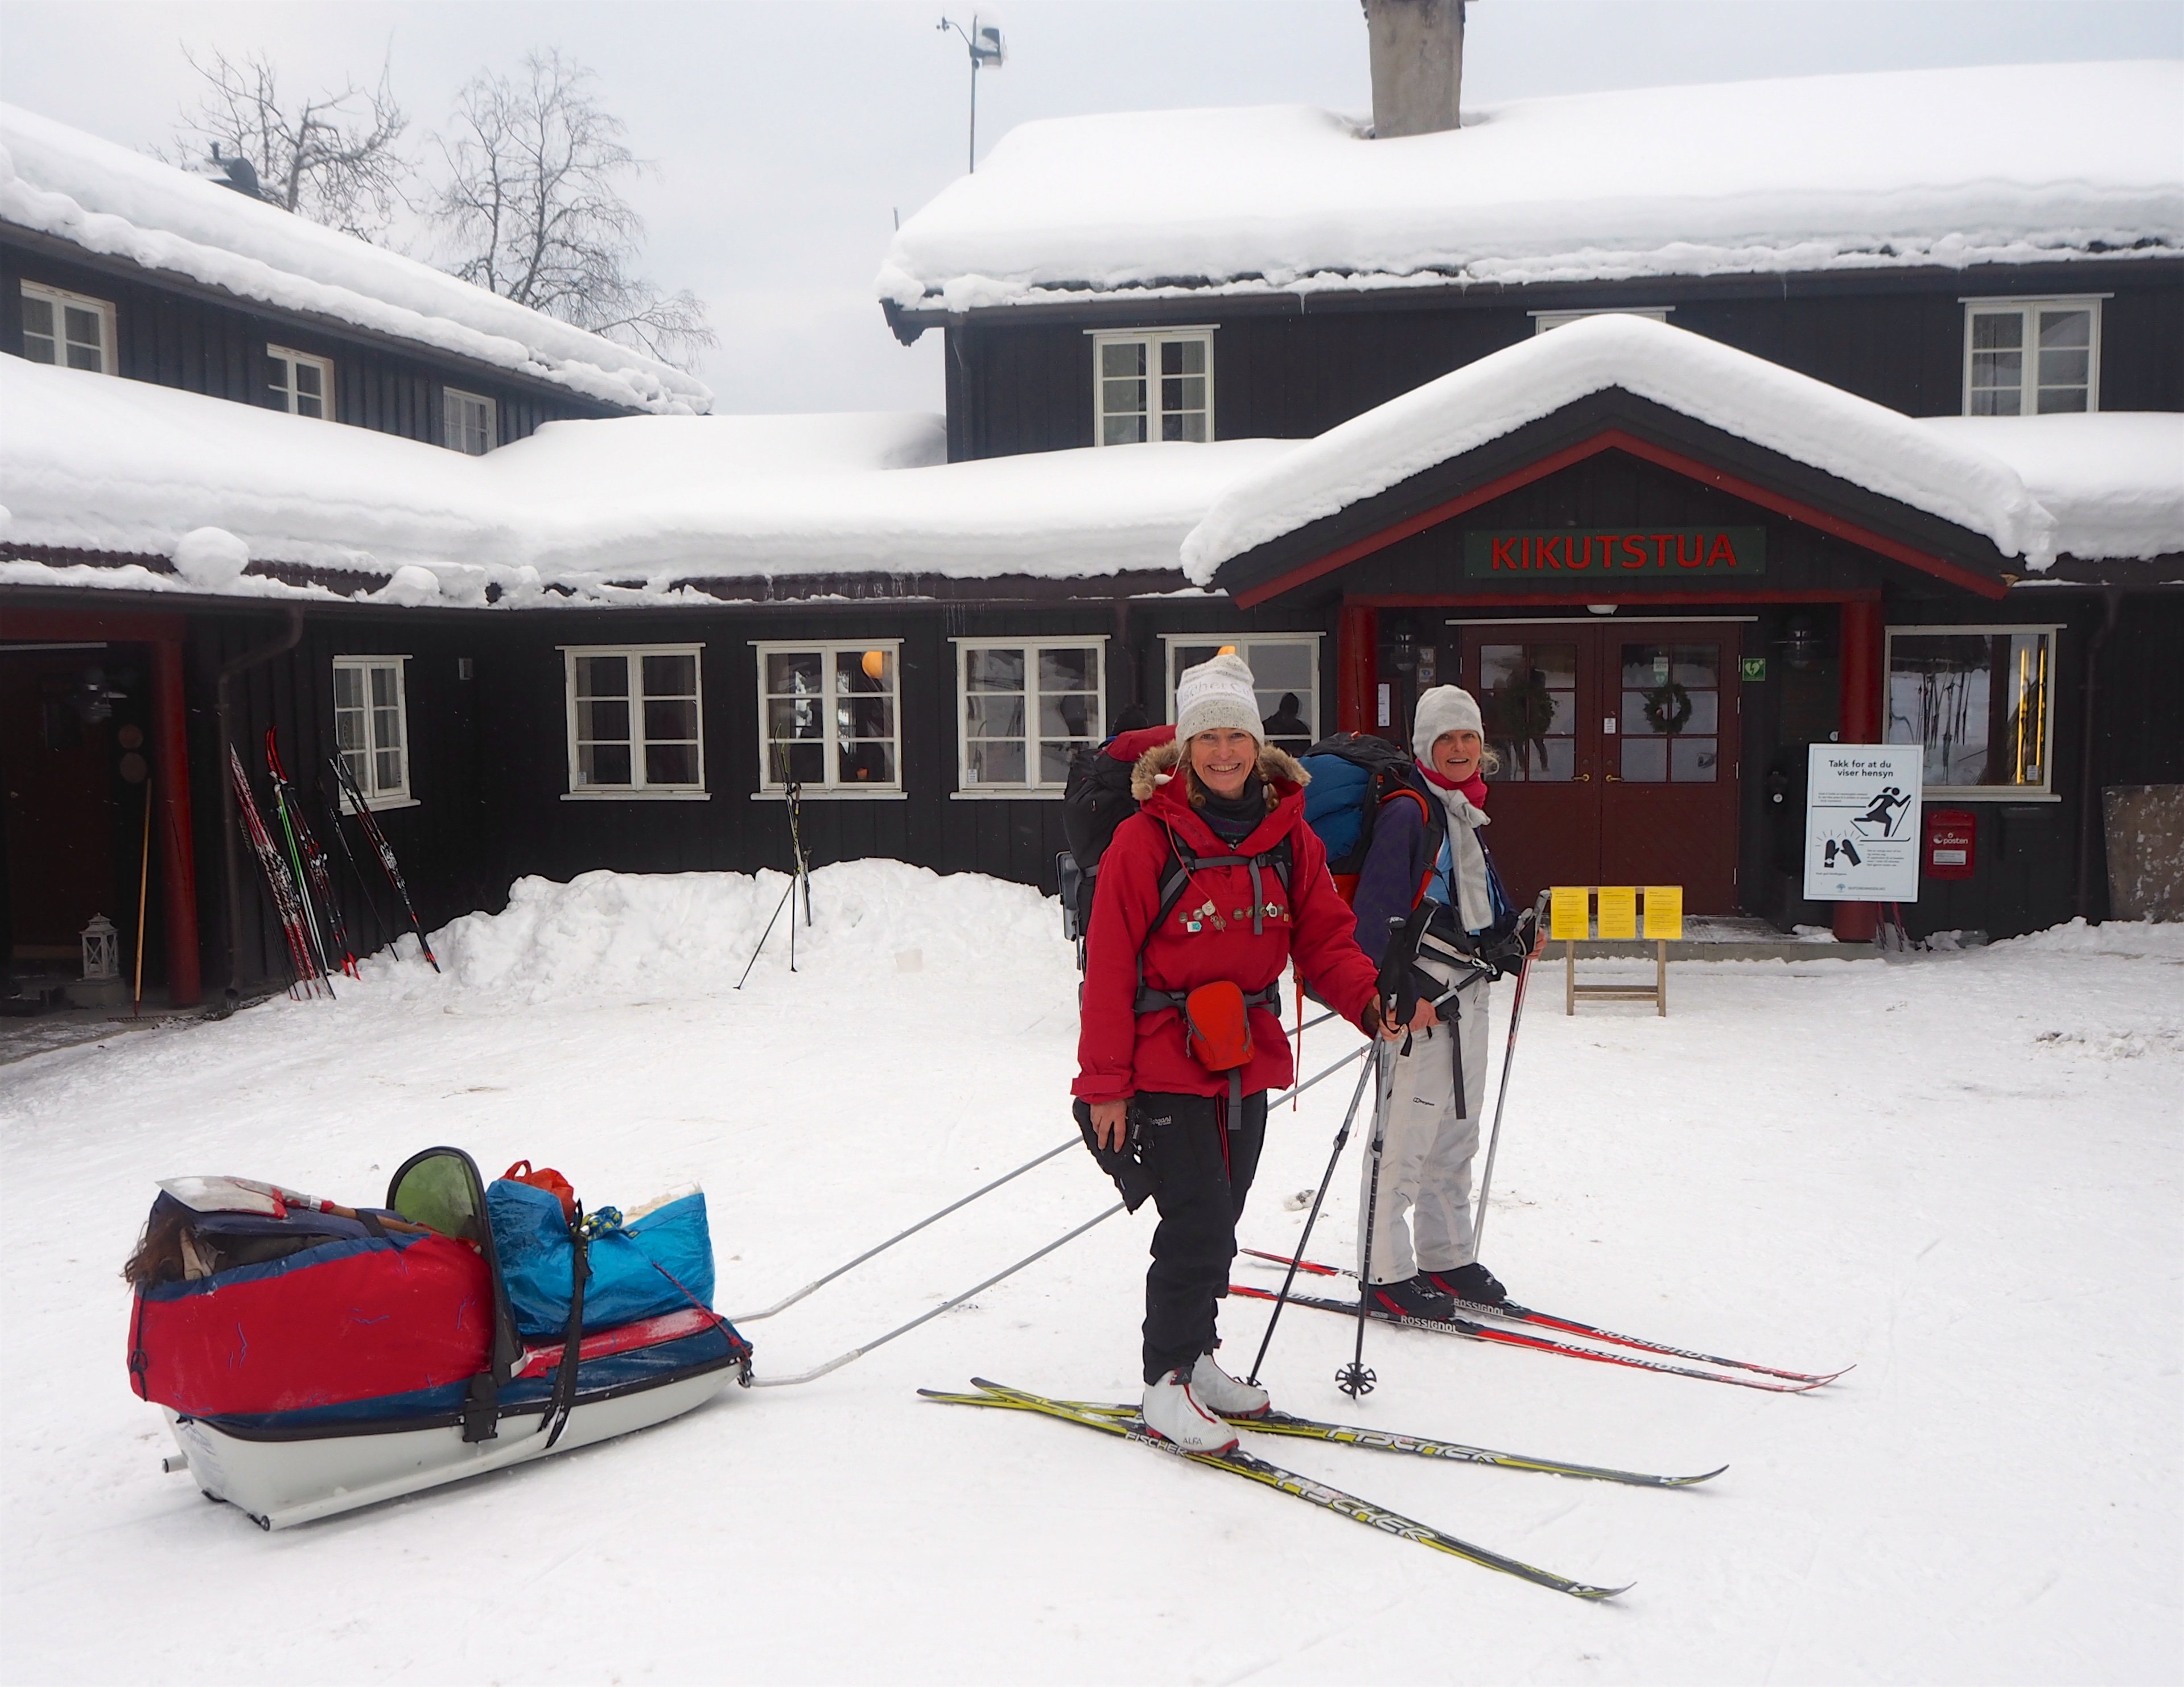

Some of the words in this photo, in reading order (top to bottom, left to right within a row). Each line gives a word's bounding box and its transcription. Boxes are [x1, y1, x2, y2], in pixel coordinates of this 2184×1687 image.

[1493, 534, 1737, 569] KIKUTSTUA
[1852, 759, 1865, 768] for
[1861, 768, 1894, 779] hensyn
[1943, 835, 1968, 845] posten
[1453, 1297, 1505, 1316] ROSSIGNOL
[1400, 1315, 1459, 1333] ROSSIGNOL
[1591, 1327, 1713, 1362] ROSSIGNOL
[1552, 1342, 1687, 1374] ROSSIGNOL
[1124, 1431, 1188, 1458] FISCHER
[1183, 1437, 1202, 1446] ALFA
[1326, 1426, 1509, 1464] FISCHER
